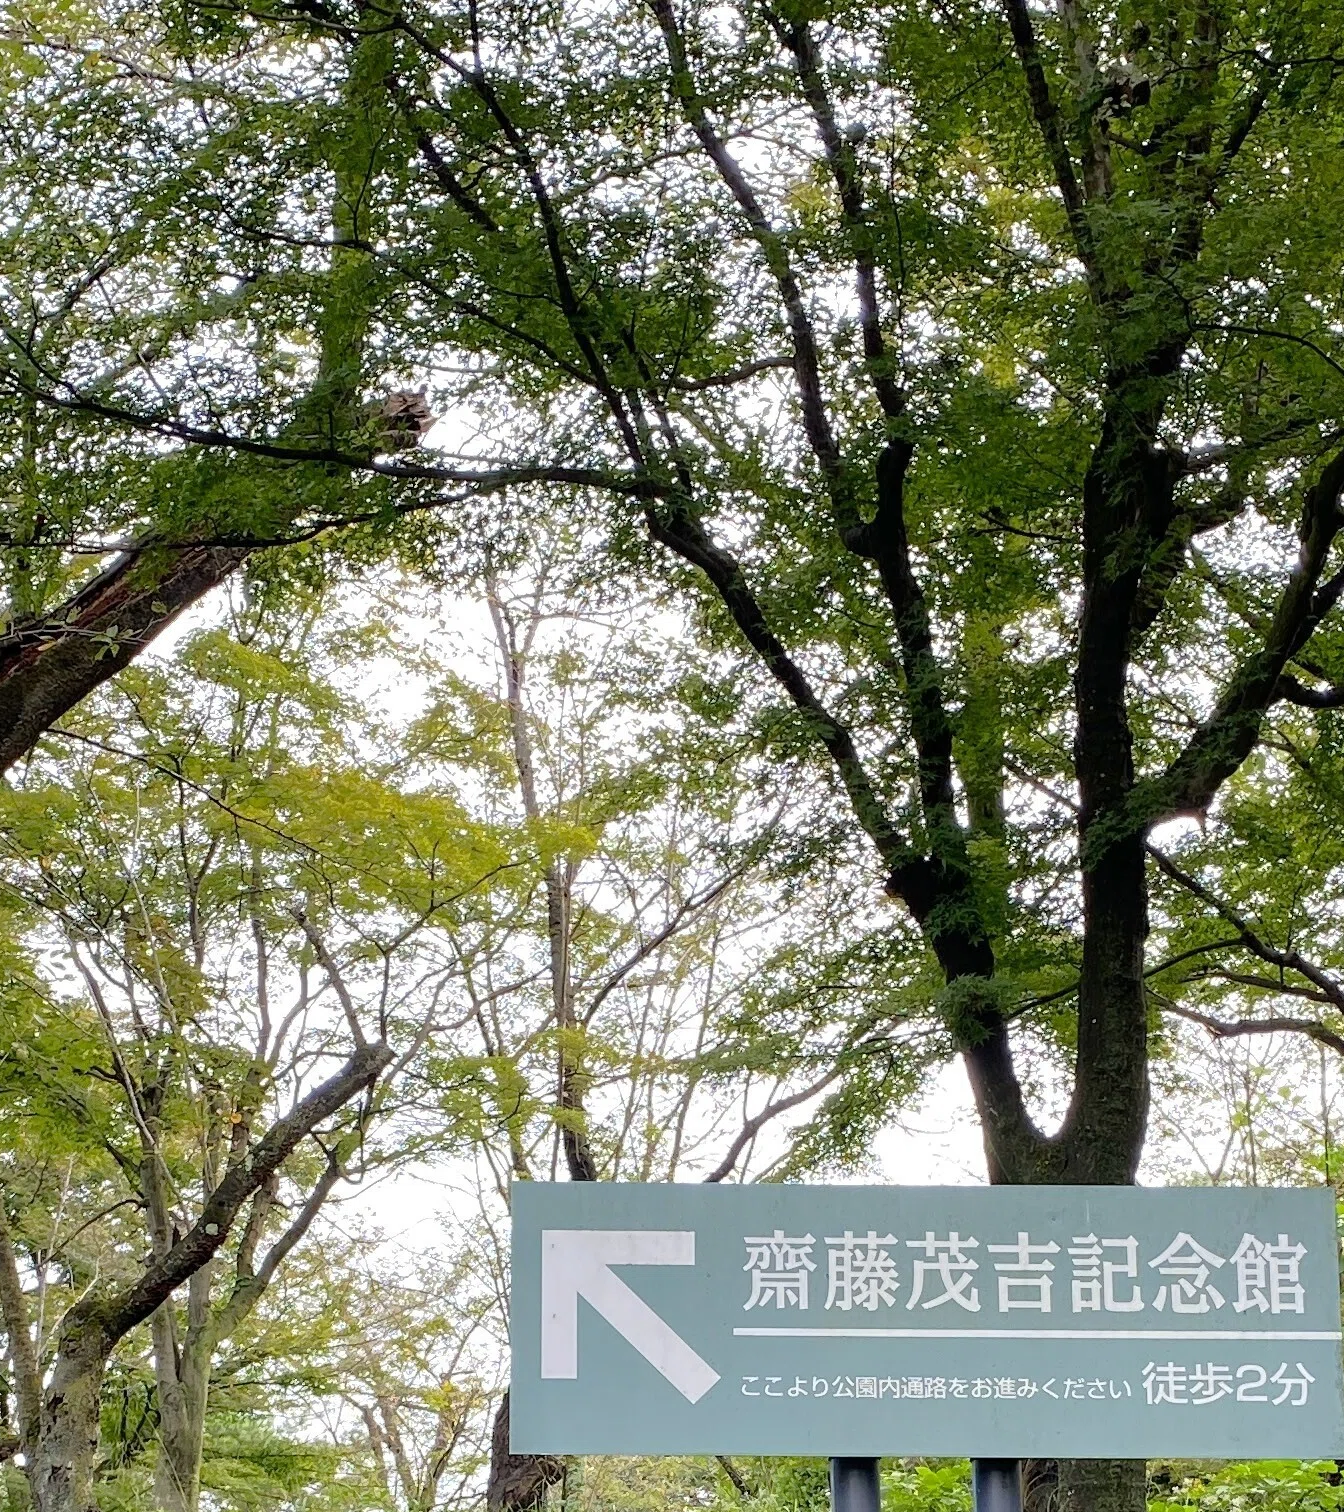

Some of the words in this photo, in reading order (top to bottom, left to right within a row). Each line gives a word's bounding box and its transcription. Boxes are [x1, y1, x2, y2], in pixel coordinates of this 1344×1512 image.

[742, 1229, 1308, 1314] 齋藤茂吉記念館
[740, 1375, 1132, 1400] ここより公園内通路をお進みください
[1141, 1361, 1316, 1406] 徒歩2分
